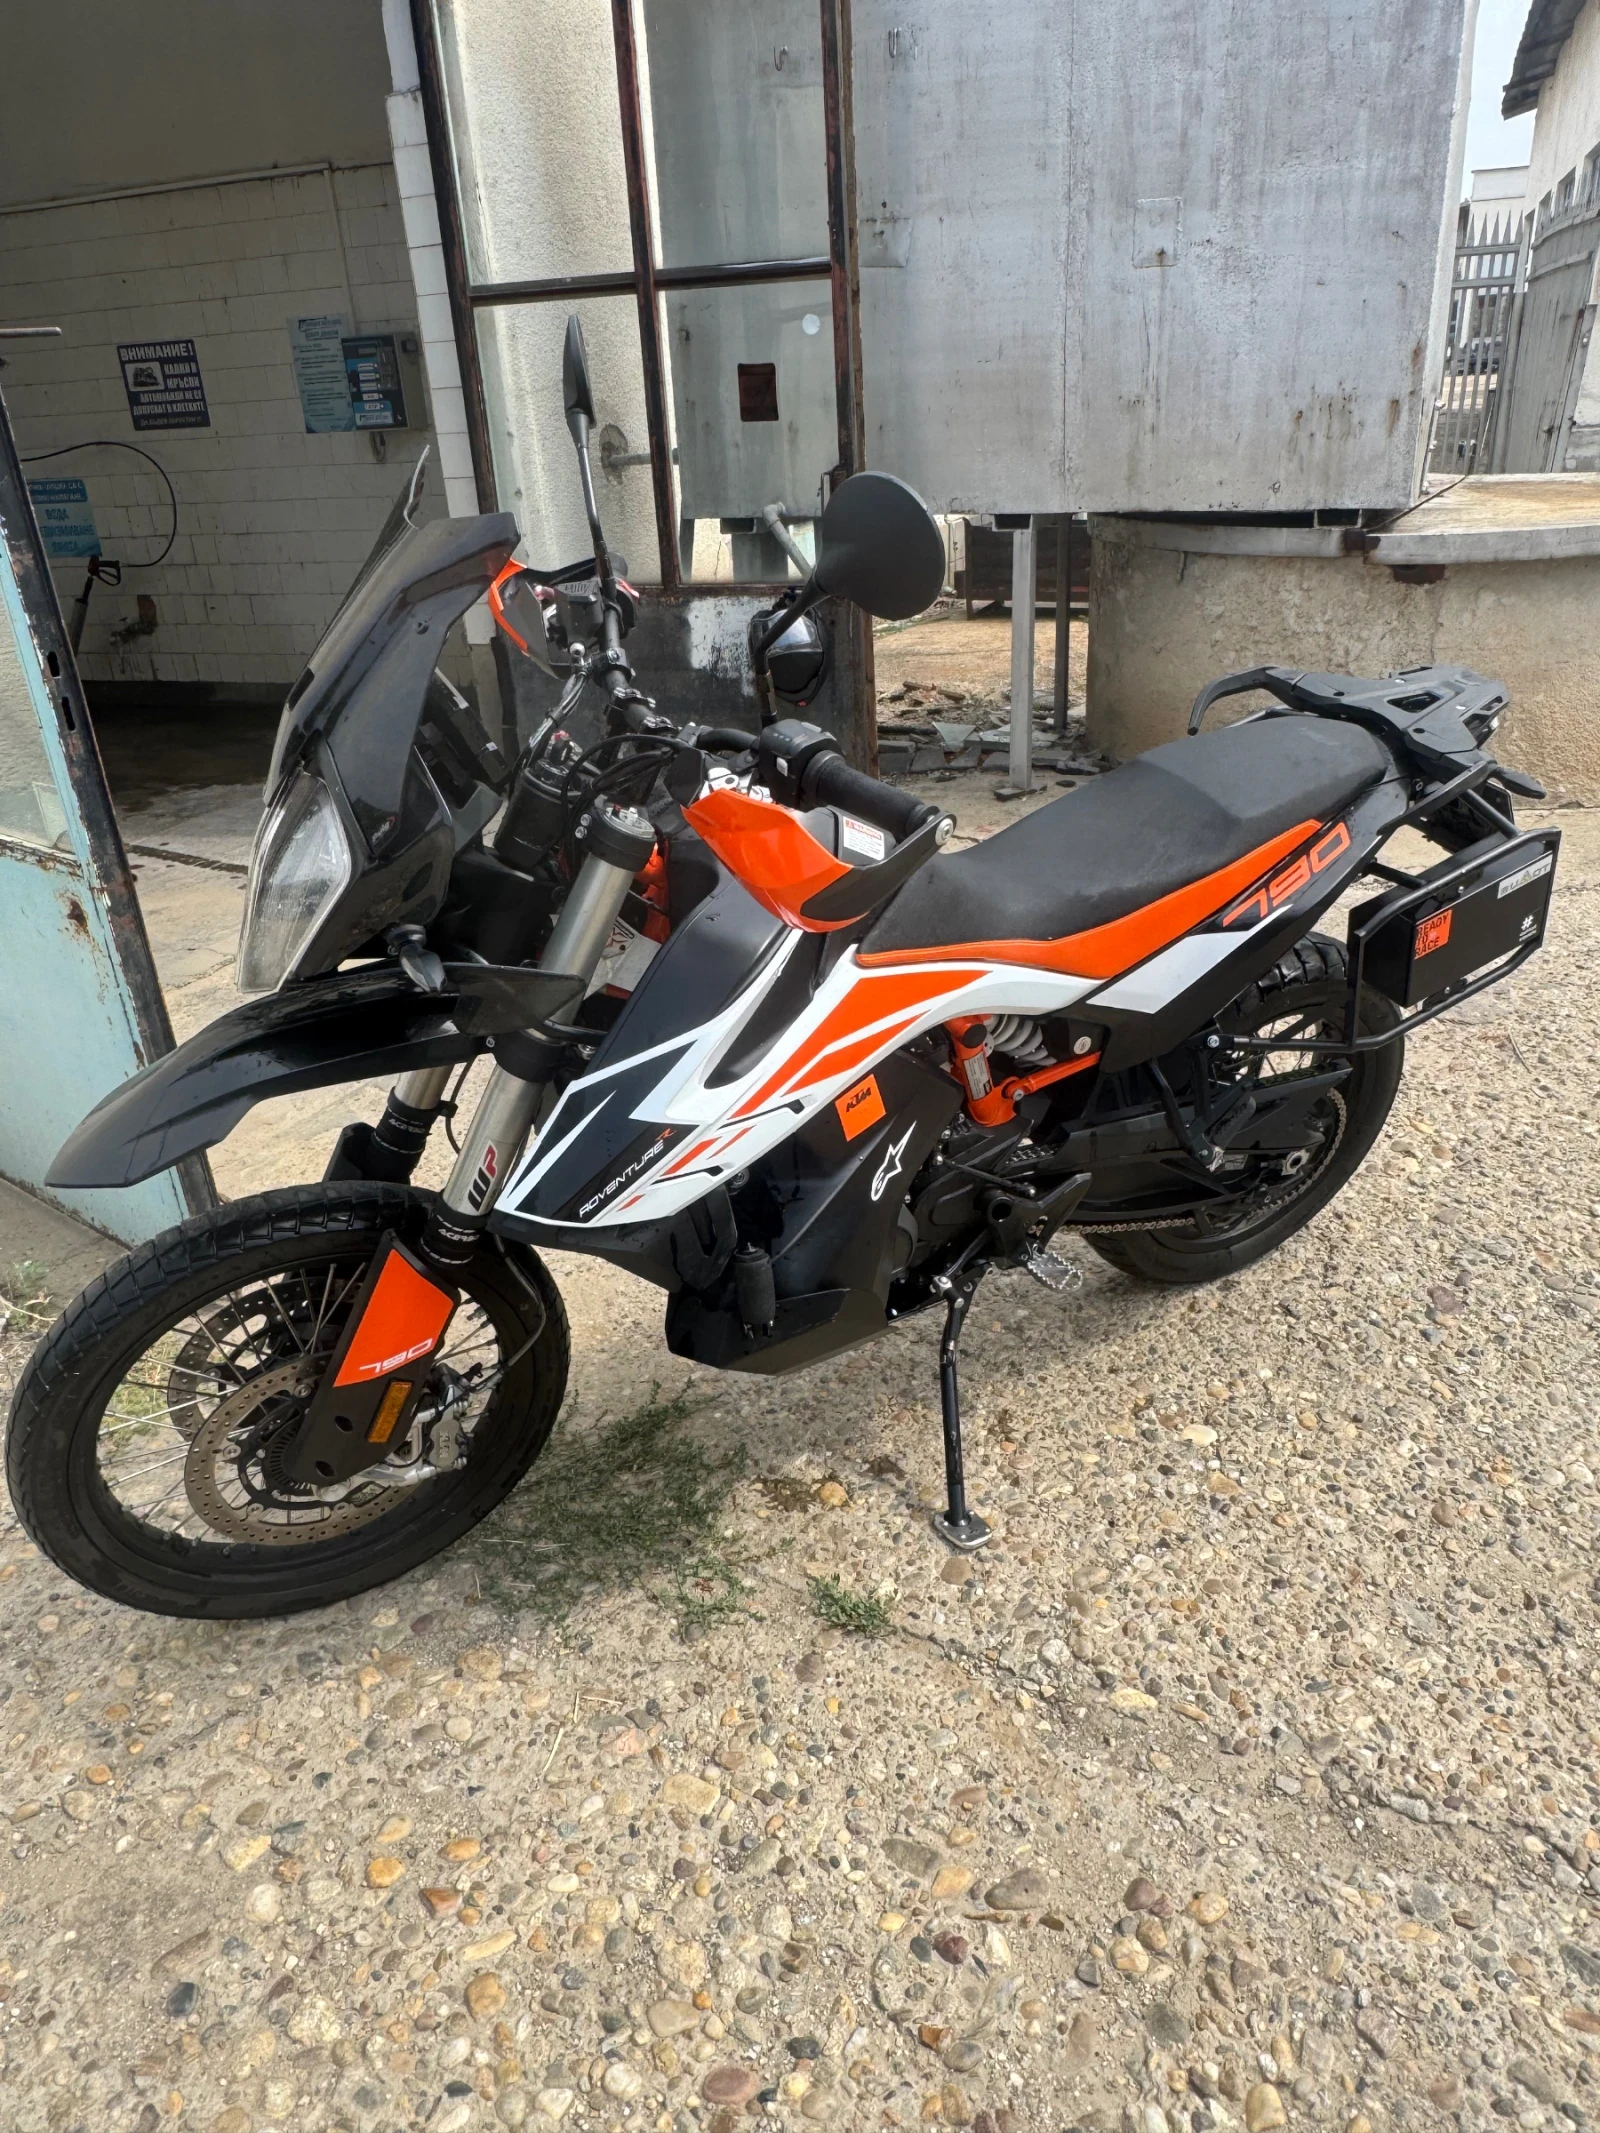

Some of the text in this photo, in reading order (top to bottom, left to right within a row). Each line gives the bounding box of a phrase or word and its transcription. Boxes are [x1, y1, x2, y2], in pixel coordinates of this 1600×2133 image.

[120, 343, 194, 361] ВНИМАНИЕ!
[1223, 822, 1350, 928] 790
[1416, 913, 1449, 938] READY
[1415, 936, 1440, 955] RACE
[845, 1087, 872, 1113] KTM
[579, 1139, 664, 1218] ADVENTURE
[359, 1337, 432, 1373] 790
